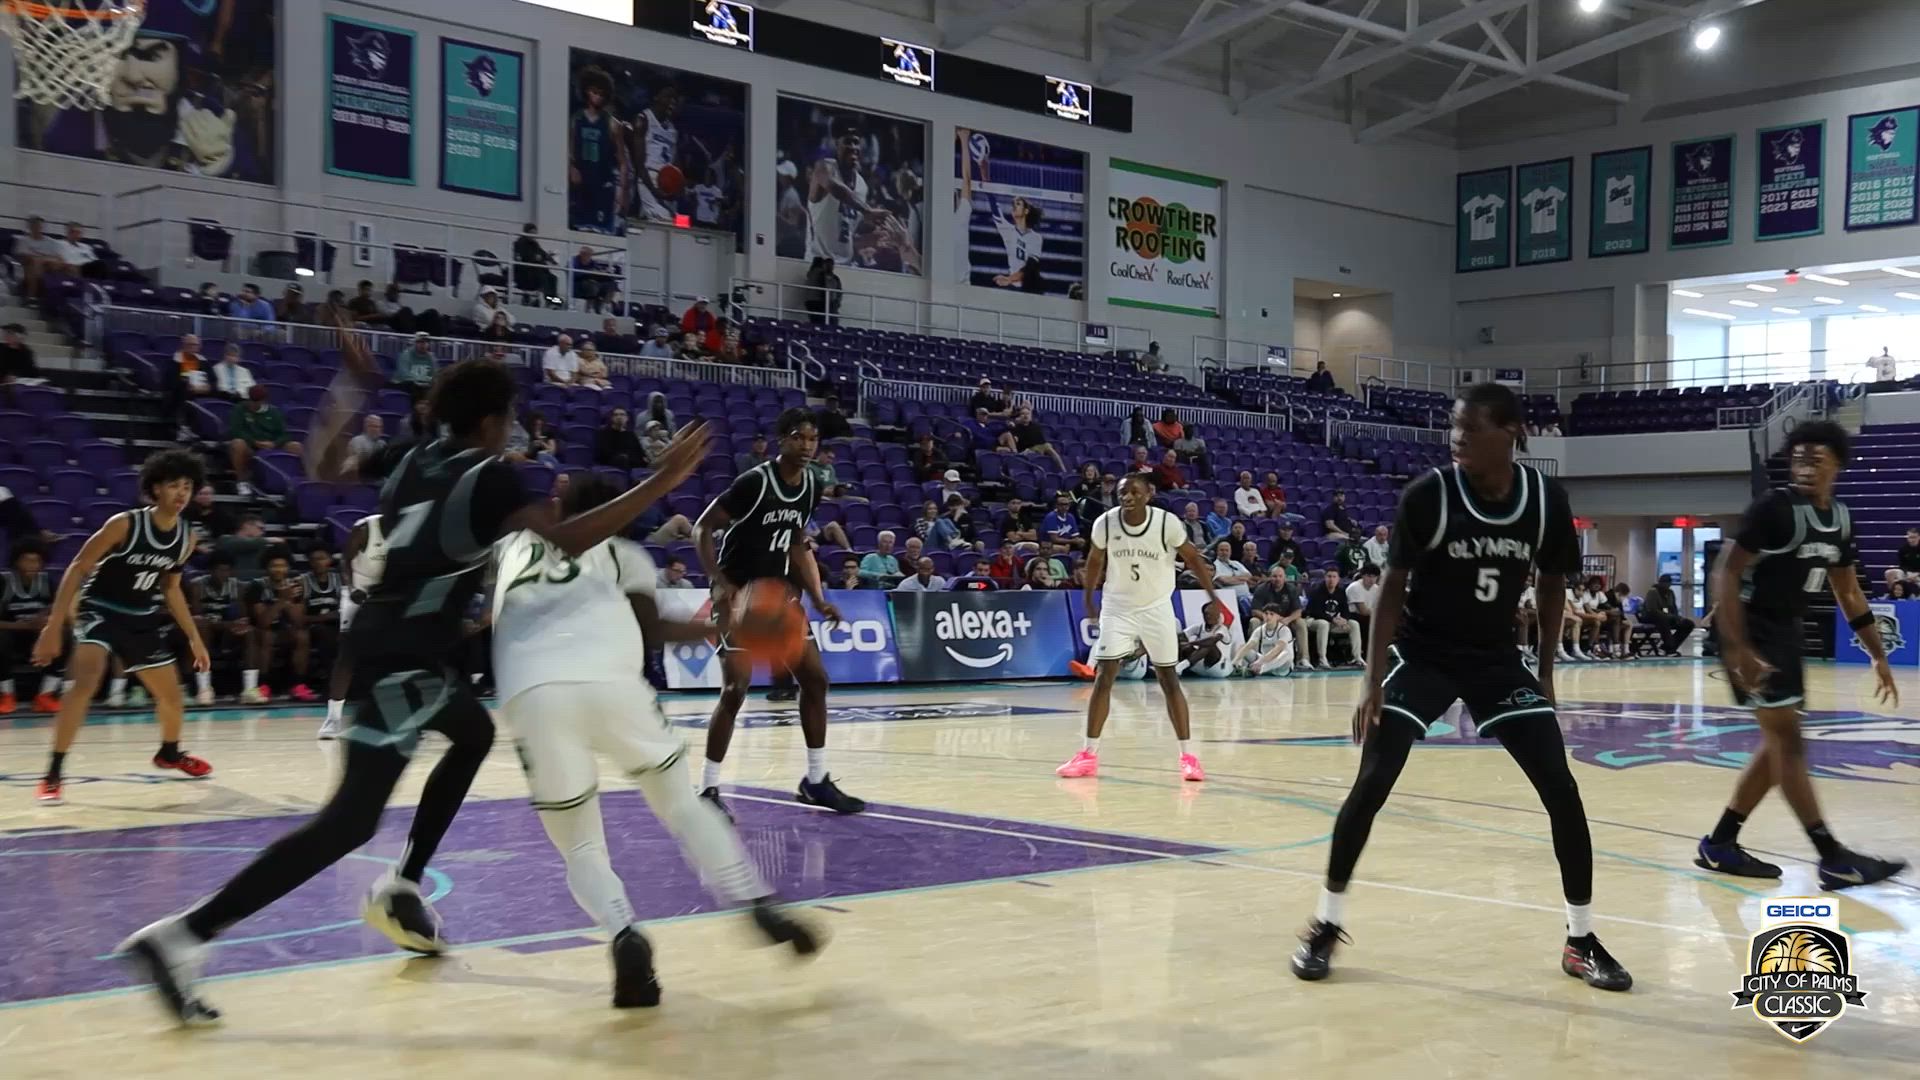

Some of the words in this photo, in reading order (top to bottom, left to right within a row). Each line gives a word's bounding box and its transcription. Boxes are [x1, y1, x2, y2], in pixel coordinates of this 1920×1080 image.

[1883, 176, 1915, 187] 2017
[1761, 191, 1789, 203] 2017
[1883, 187, 1914, 199] 2021
[1760, 201, 1789, 214] 2023
[1108, 196, 1217, 238] CROWTHER
[1115, 226, 1206, 262] ROOFING
[1605, 239, 1633, 250] 2023
[769, 529, 792, 552] 14
[1137, 549, 1160, 561] DAME
[133, 571, 159, 590] 10
[1130, 564, 1140, 581] 5
[1474, 568, 1500, 602] 5
[934, 603, 1031, 640] alexa+
